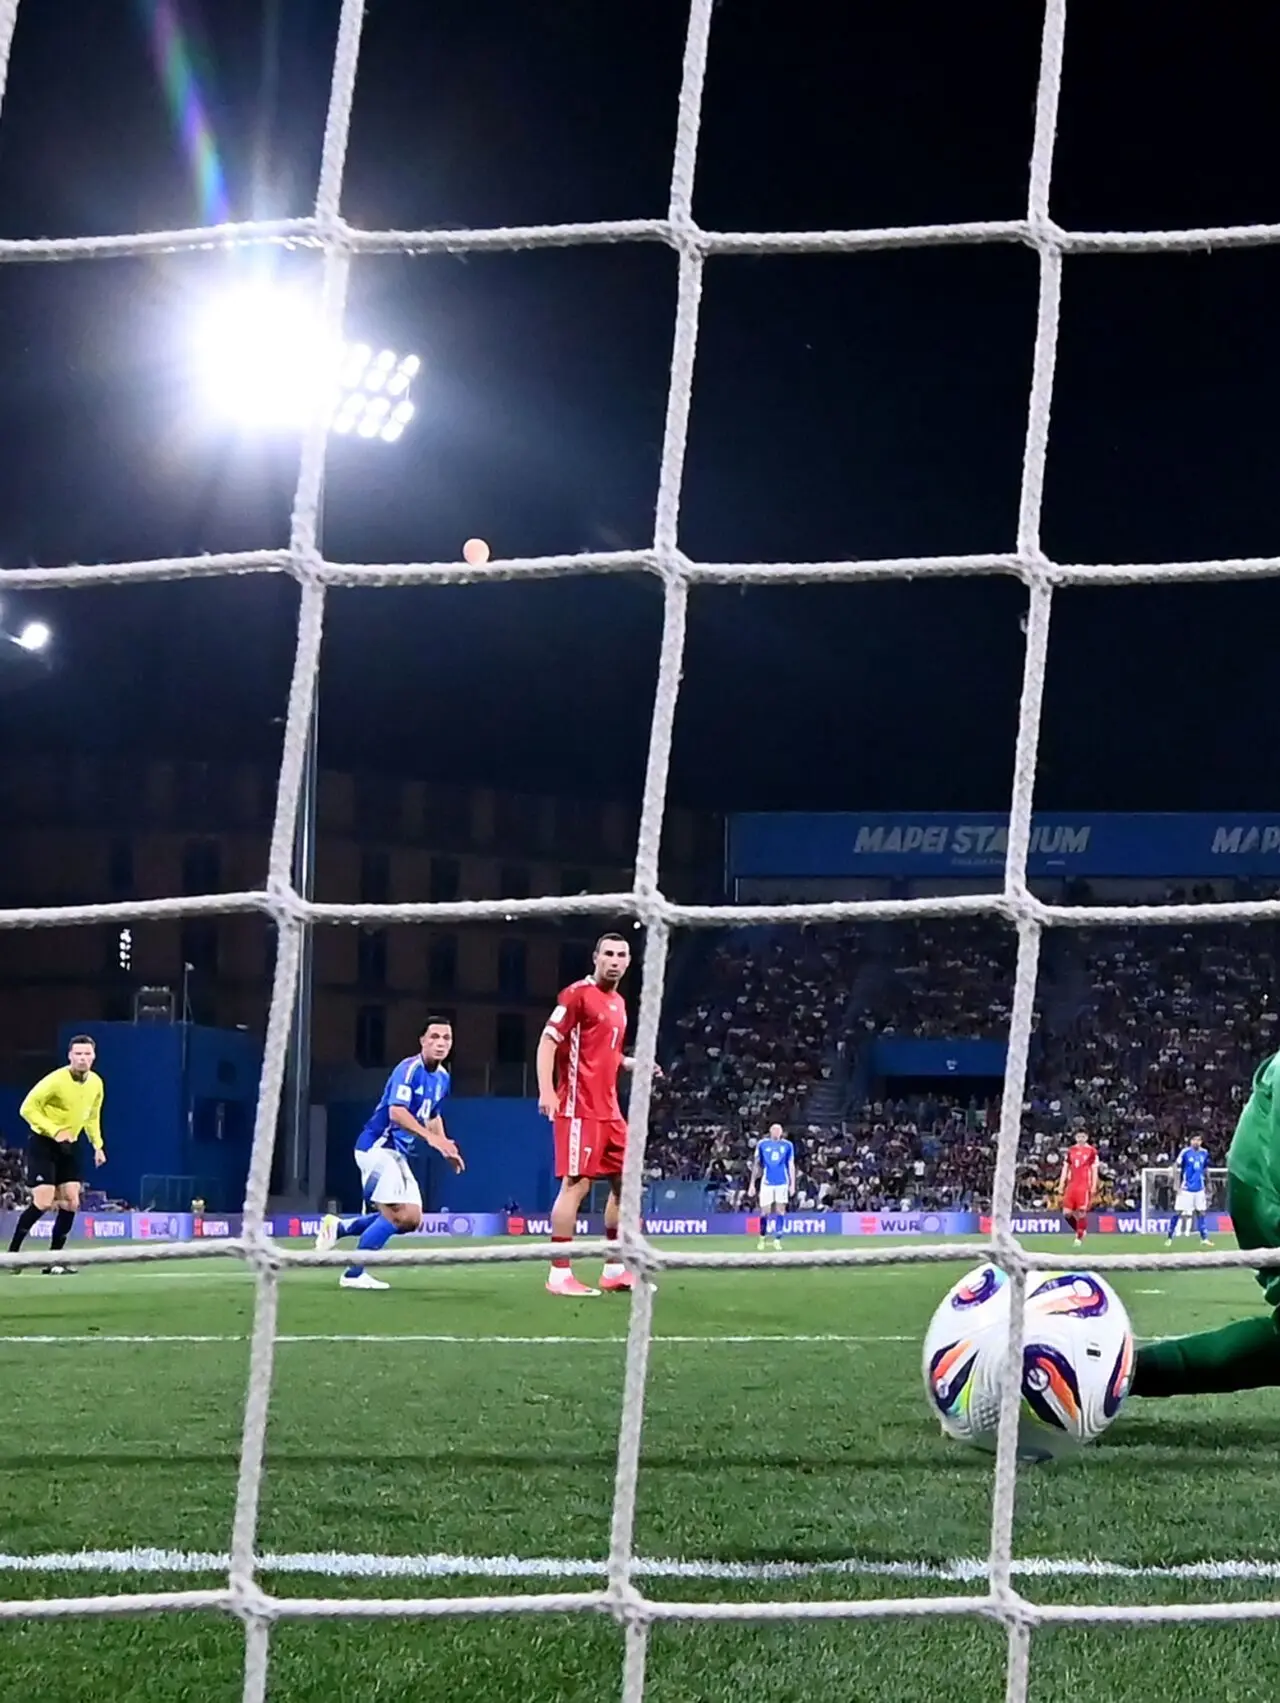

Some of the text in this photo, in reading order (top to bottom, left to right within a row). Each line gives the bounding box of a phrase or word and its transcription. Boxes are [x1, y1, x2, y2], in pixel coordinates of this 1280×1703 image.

[853, 826, 1091, 853] MAPEI STAIUM
[583, 1147, 592, 1169] 7
[527, 1220, 588, 1234] WUH
[1010, 1219, 1061, 1233] URTH
